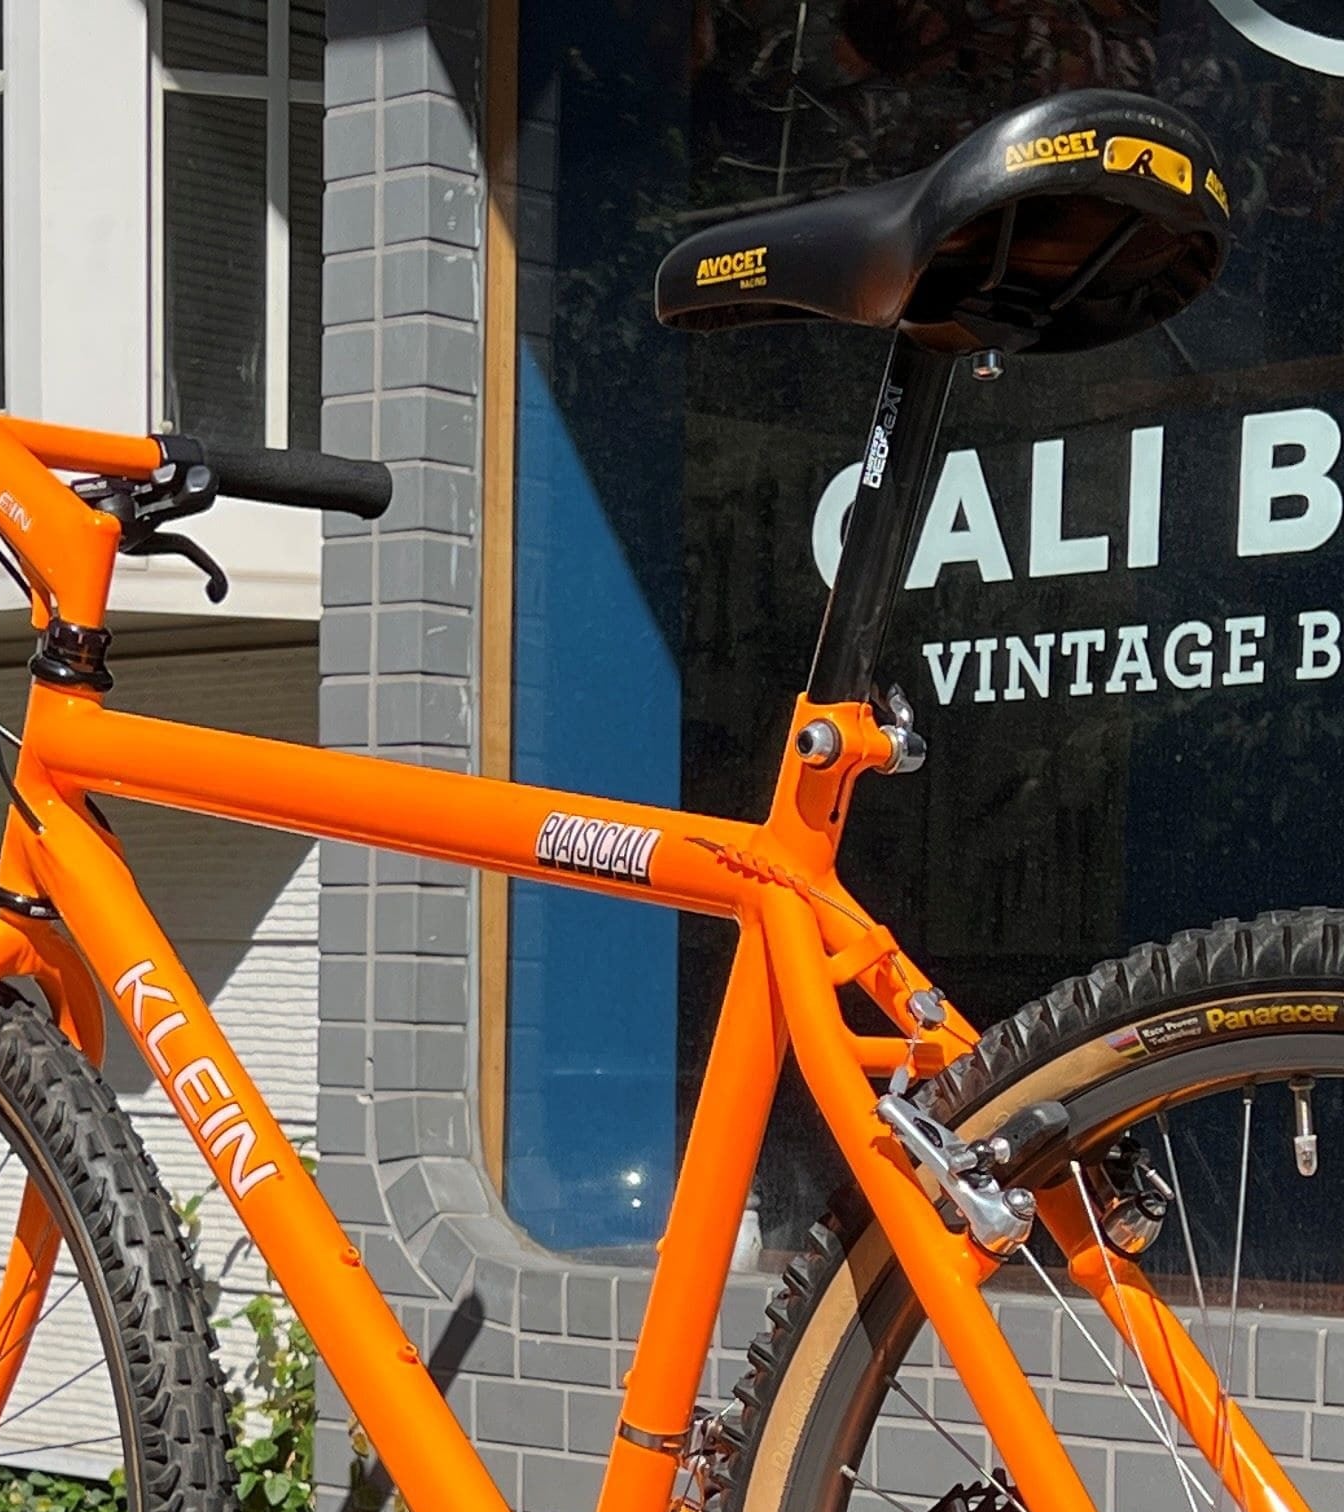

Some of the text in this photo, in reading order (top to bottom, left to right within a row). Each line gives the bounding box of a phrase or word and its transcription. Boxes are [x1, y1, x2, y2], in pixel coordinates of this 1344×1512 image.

[1006, 130, 1098, 169] AVOCET
[696, 247, 767, 282] AVOCET
[922, 616, 1265, 706] VINTAGE
[536, 812, 661, 877] RASCAL
[1205, 1004, 1339, 1032] Panaracer
[114, 959, 280, 1200] KLEIN
